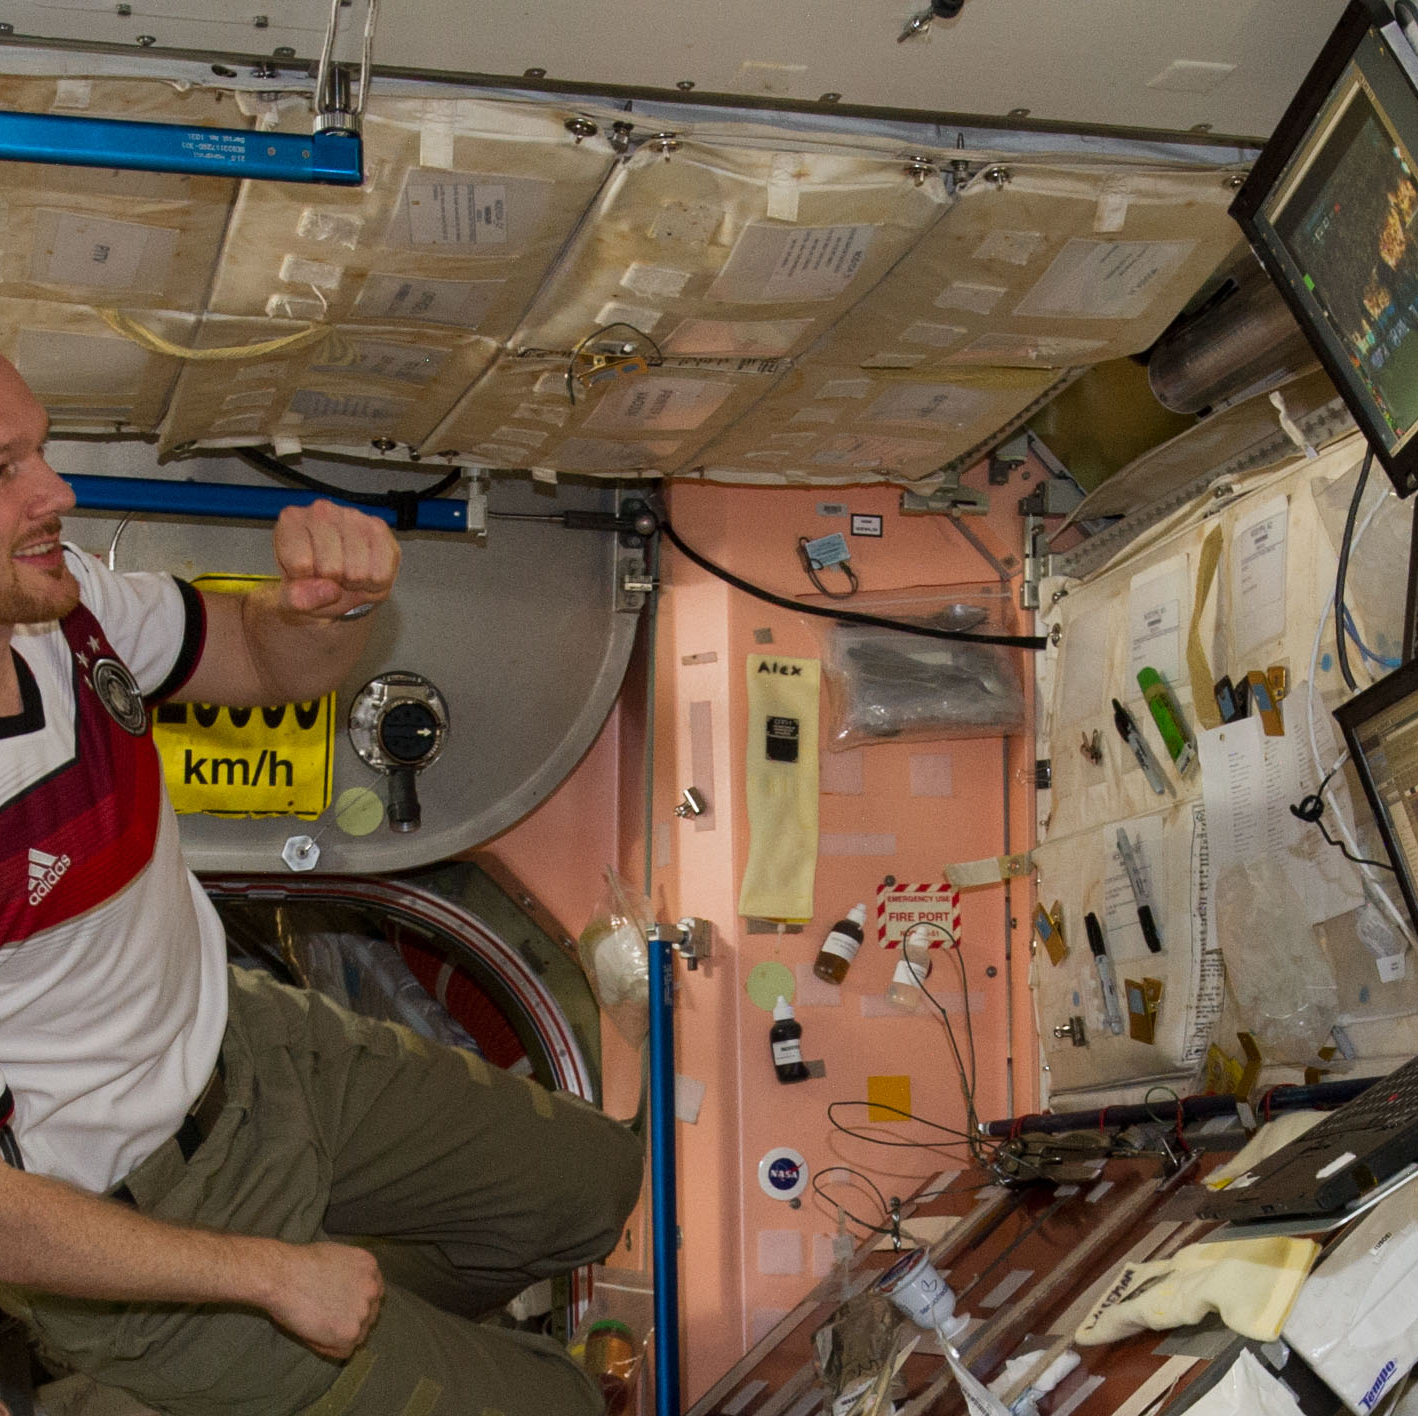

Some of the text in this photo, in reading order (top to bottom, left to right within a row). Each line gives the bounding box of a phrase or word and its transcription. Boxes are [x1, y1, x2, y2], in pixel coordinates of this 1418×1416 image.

[758, 661, 803, 677] Alex
[184, 749, 294, 787] km/h
[29, 854, 72, 906] adidas
[887, 894, 951, 903] EMERGENCY USE
[888, 911, 950, 923] FIRE PORT
[768, 1168, 800, 1181] NASA
[1358, 1360, 1397, 1411] Tempo
